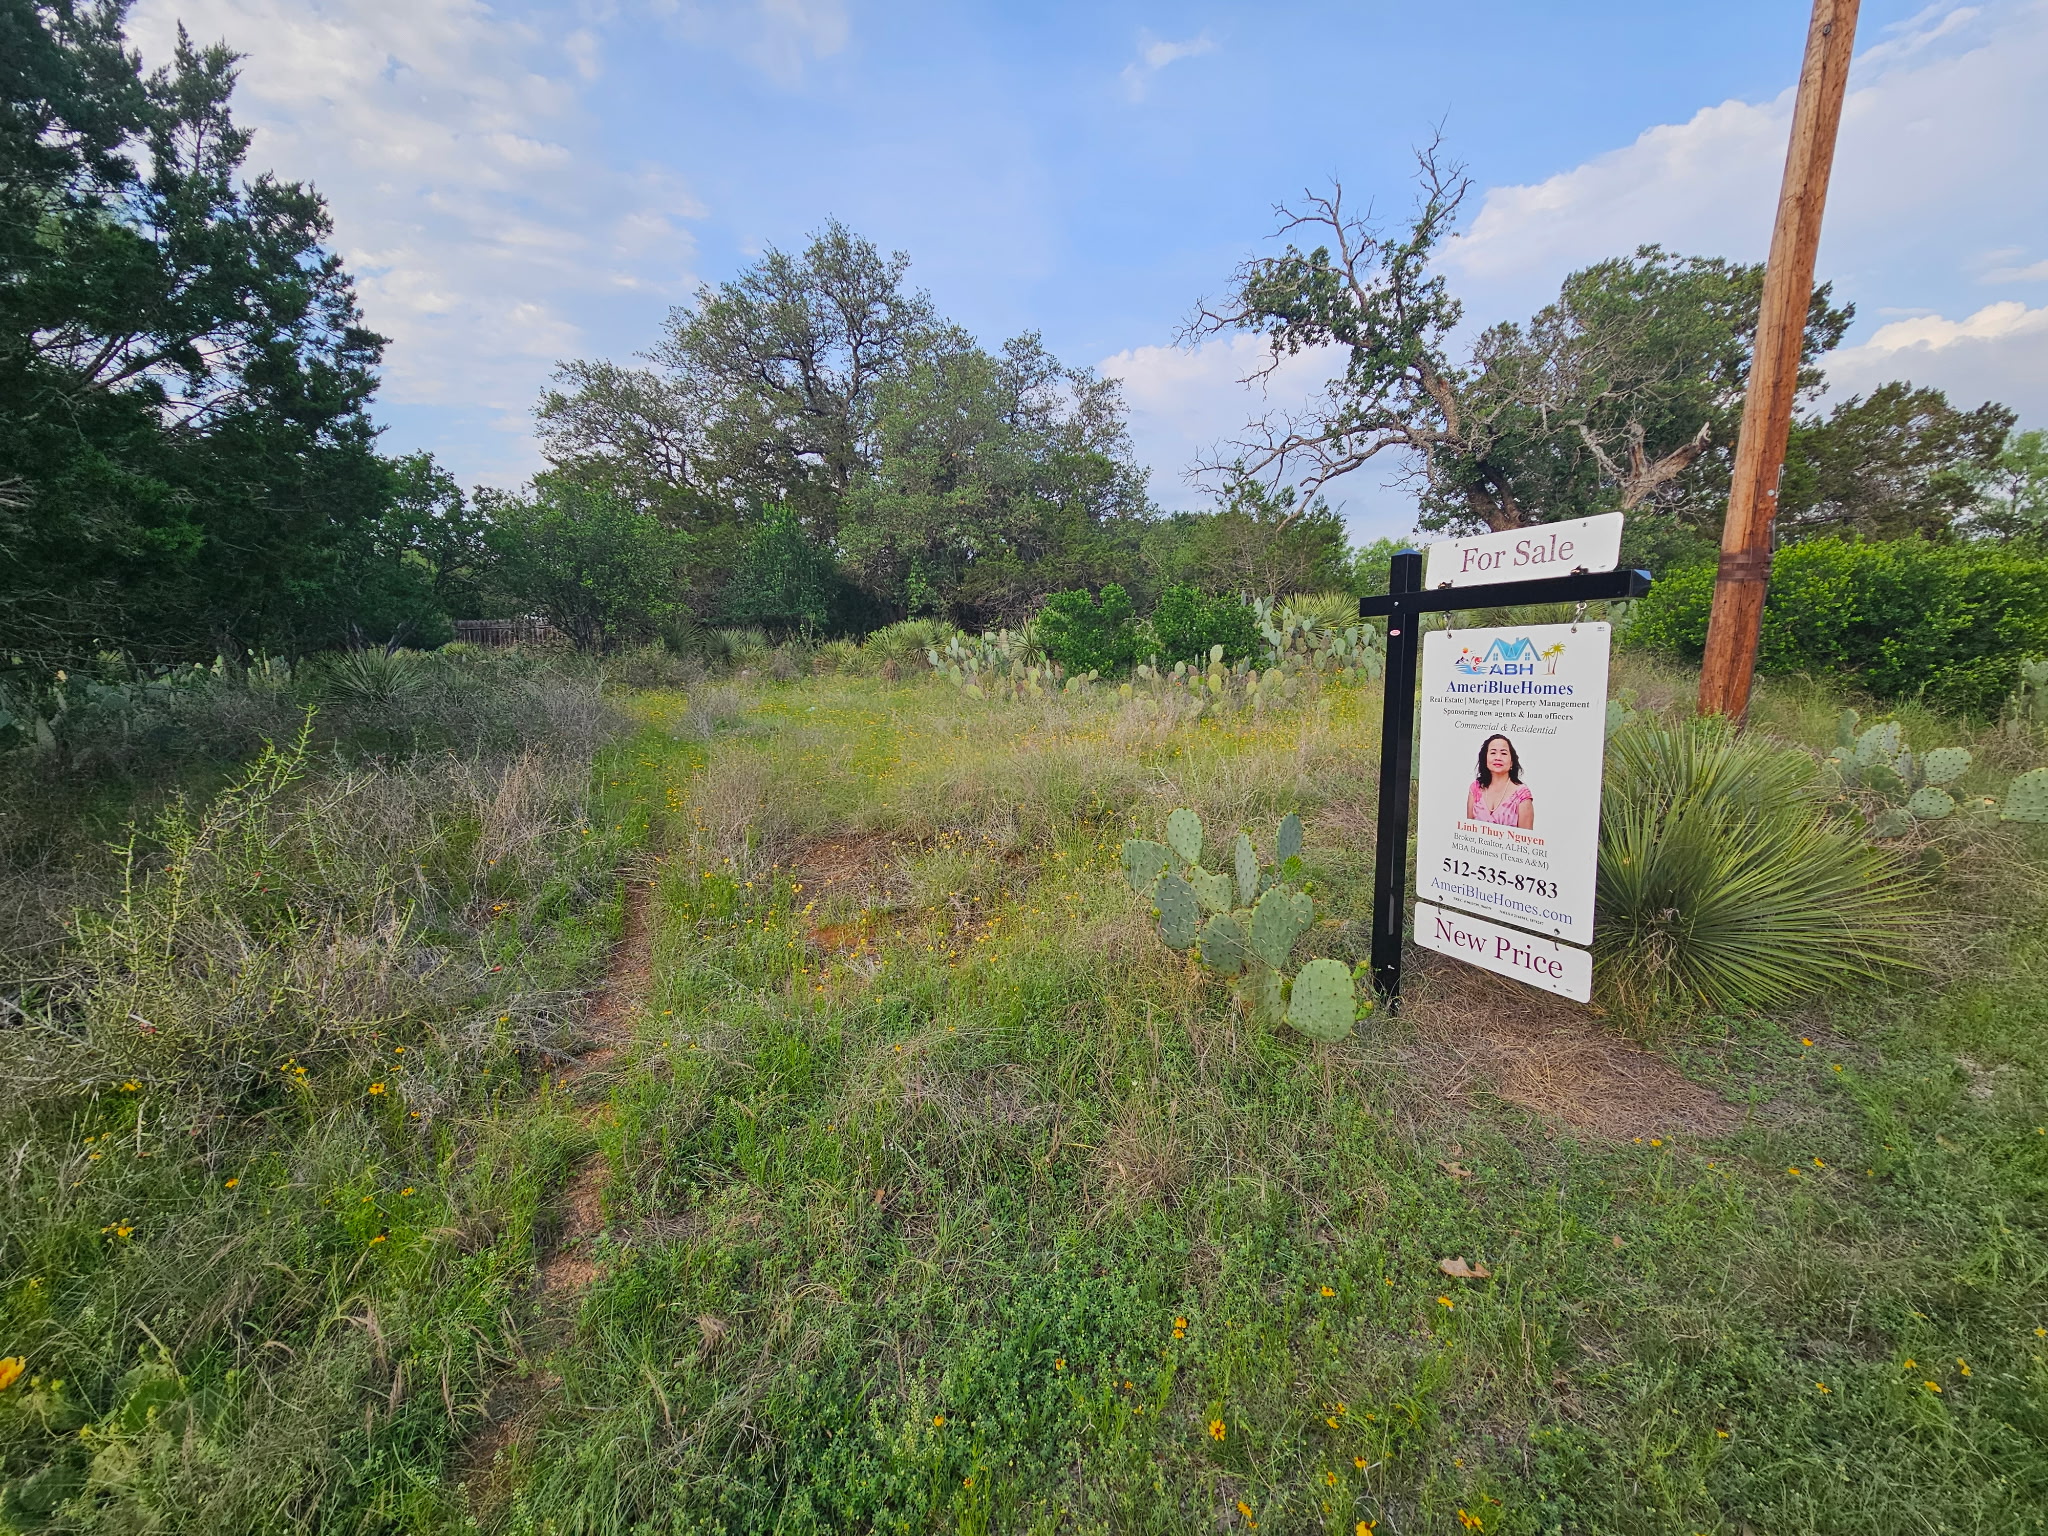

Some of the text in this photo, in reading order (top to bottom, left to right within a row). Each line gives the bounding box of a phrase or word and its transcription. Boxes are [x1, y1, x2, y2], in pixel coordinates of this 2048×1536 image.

[1460, 534, 1574, 573] For Sale
[1489, 663, 1534, 675] ABH
[1446, 681, 1574, 695] AmeriBlueHomes
[1429, 696, 1443, 704] Real
[1468, 697, 1500, 706] Mortgage
[1505, 698, 1537, 707] Property
[1538, 700, 1590, 709] Management
[1443, 708, 1478, 717] Sponsoring
[1495, 711, 1516, 719] agents
[1454, 720, 1558, 735] Commercial & Residential
[1454, 833, 1548, 858] Broker, Realtor, ALHS, GRI
[1457, 821, 1544, 846] Linh Thuy Nguyen
[1452, 842, 1549, 871] MBA Business (Texas A&M)
[1442, 857, 1558, 899] 512-535-8783
[1430, 876, 1573, 925] AmeriBlueHomes.com
[1434, 916, 1487, 953] New
[1494, 935, 1563, 979] Price
